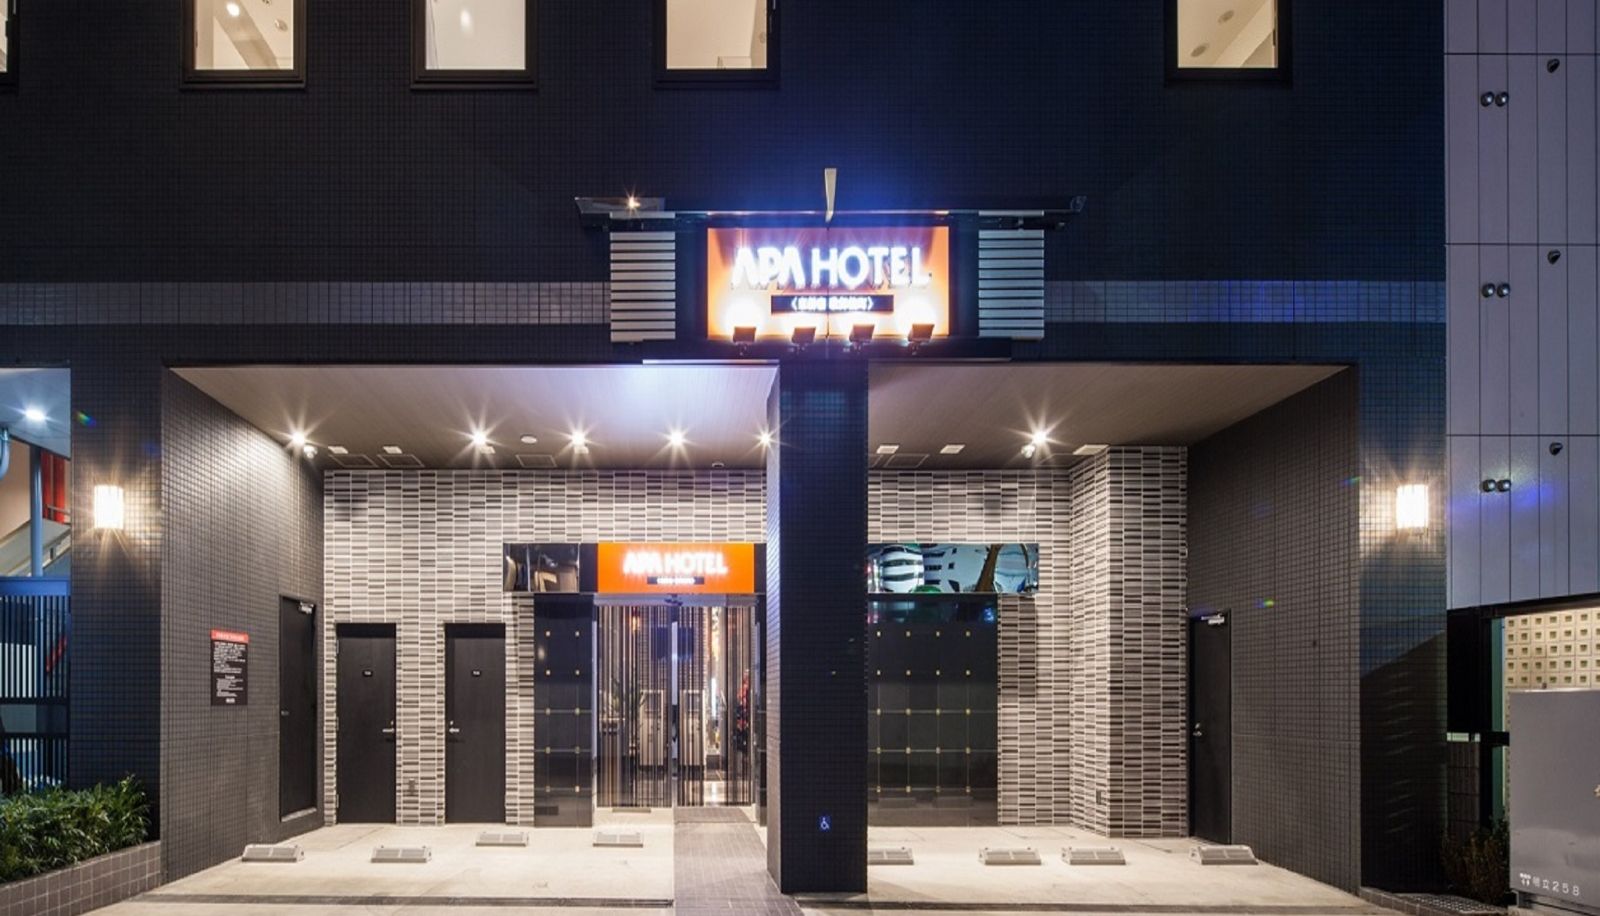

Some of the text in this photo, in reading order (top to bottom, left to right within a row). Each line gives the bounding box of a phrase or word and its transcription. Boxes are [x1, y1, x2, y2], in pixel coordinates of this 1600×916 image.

[732, 246, 931, 289] APA HOTEL
[624, 552, 727, 574] APA HOTEL
